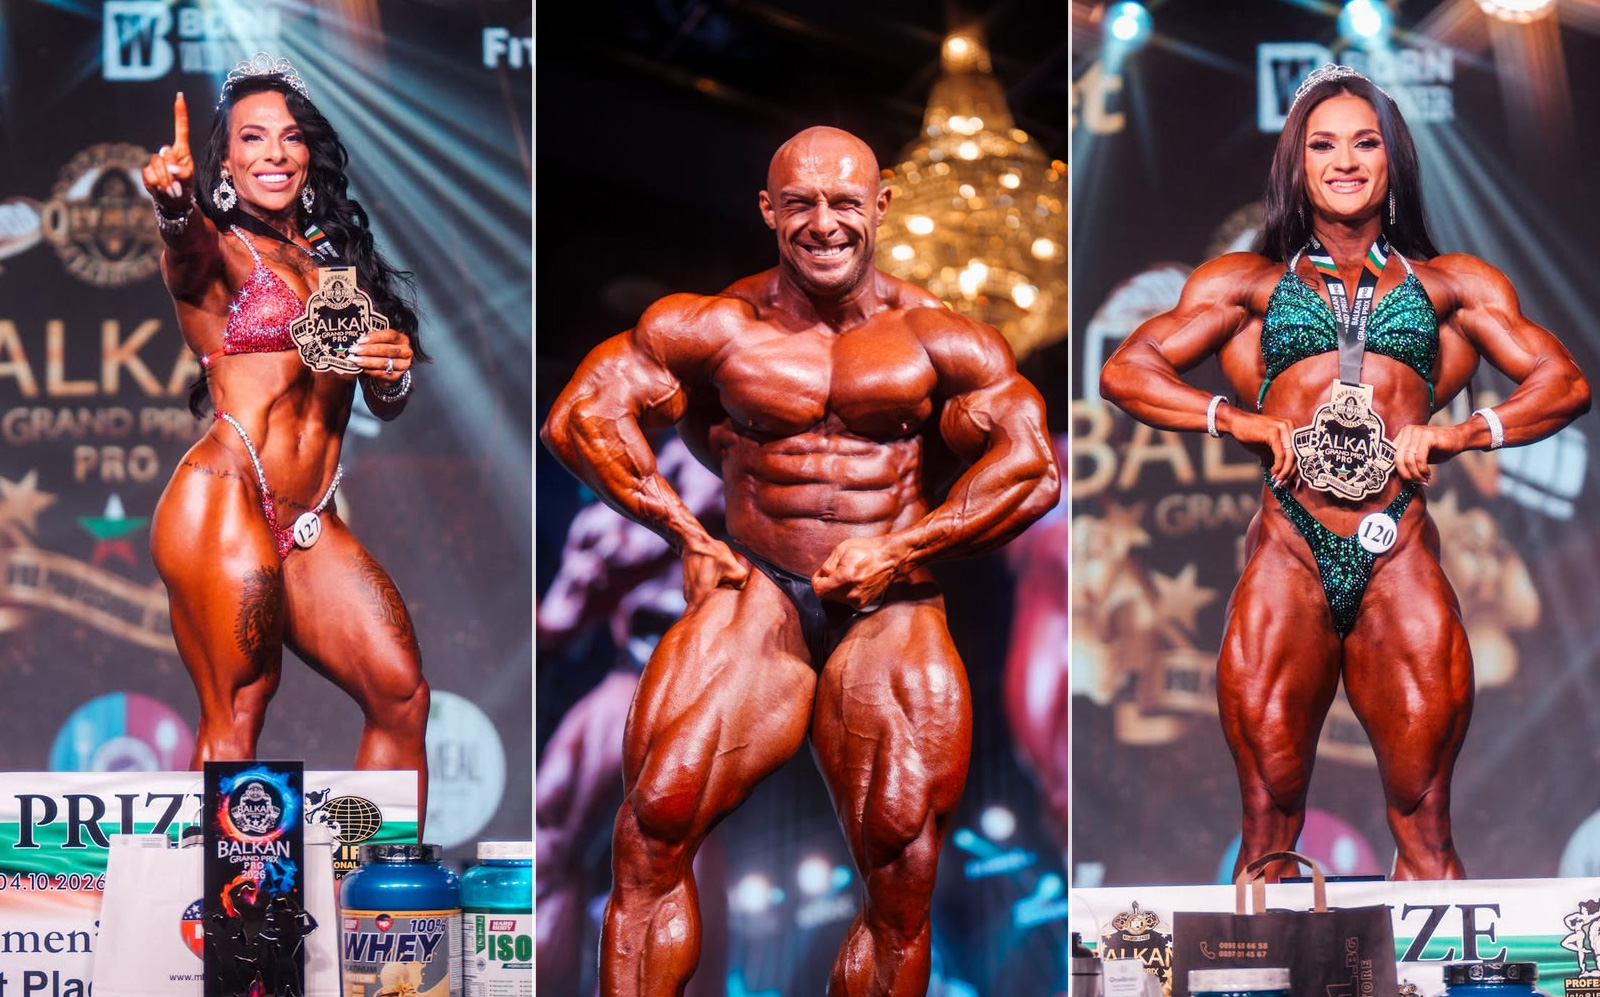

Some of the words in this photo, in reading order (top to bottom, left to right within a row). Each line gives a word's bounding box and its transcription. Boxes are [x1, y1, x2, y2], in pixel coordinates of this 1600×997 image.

[1350, 300, 1362, 326] BALKAN
[1361, 300, 1371, 315] PRIX
[305, 316, 372, 336] BALKAN
[321, 331, 344, 339] GRAND
[1357, 315, 1368, 341] GRAND
[332, 335, 348, 343] PRO
[2, 406, 133, 445] GRAND
[1309, 431, 1383, 459] BALKAN
[73, 445, 159, 483] PRO
[1324, 448, 1350, 457] GRAND
[1350, 451, 1366, 462] PRIX
[1336, 454, 1353, 464] PRO
[297, 518, 320, 542] 127
[1363, 521, 1394, 544] 120
[217, 840, 291, 859] BALKAN
[229, 855, 260, 864] GRAND
[260, 855, 280, 864] PRIX
[243, 861, 265, 870] PRO
[0, 873, 106, 891] 04.10.2026
[241, 870, 267, 880] 2026
[409, 918, 447, 933] 100%
[344, 931, 444, 964] WHEY
[488, 934, 532, 962] ISO
